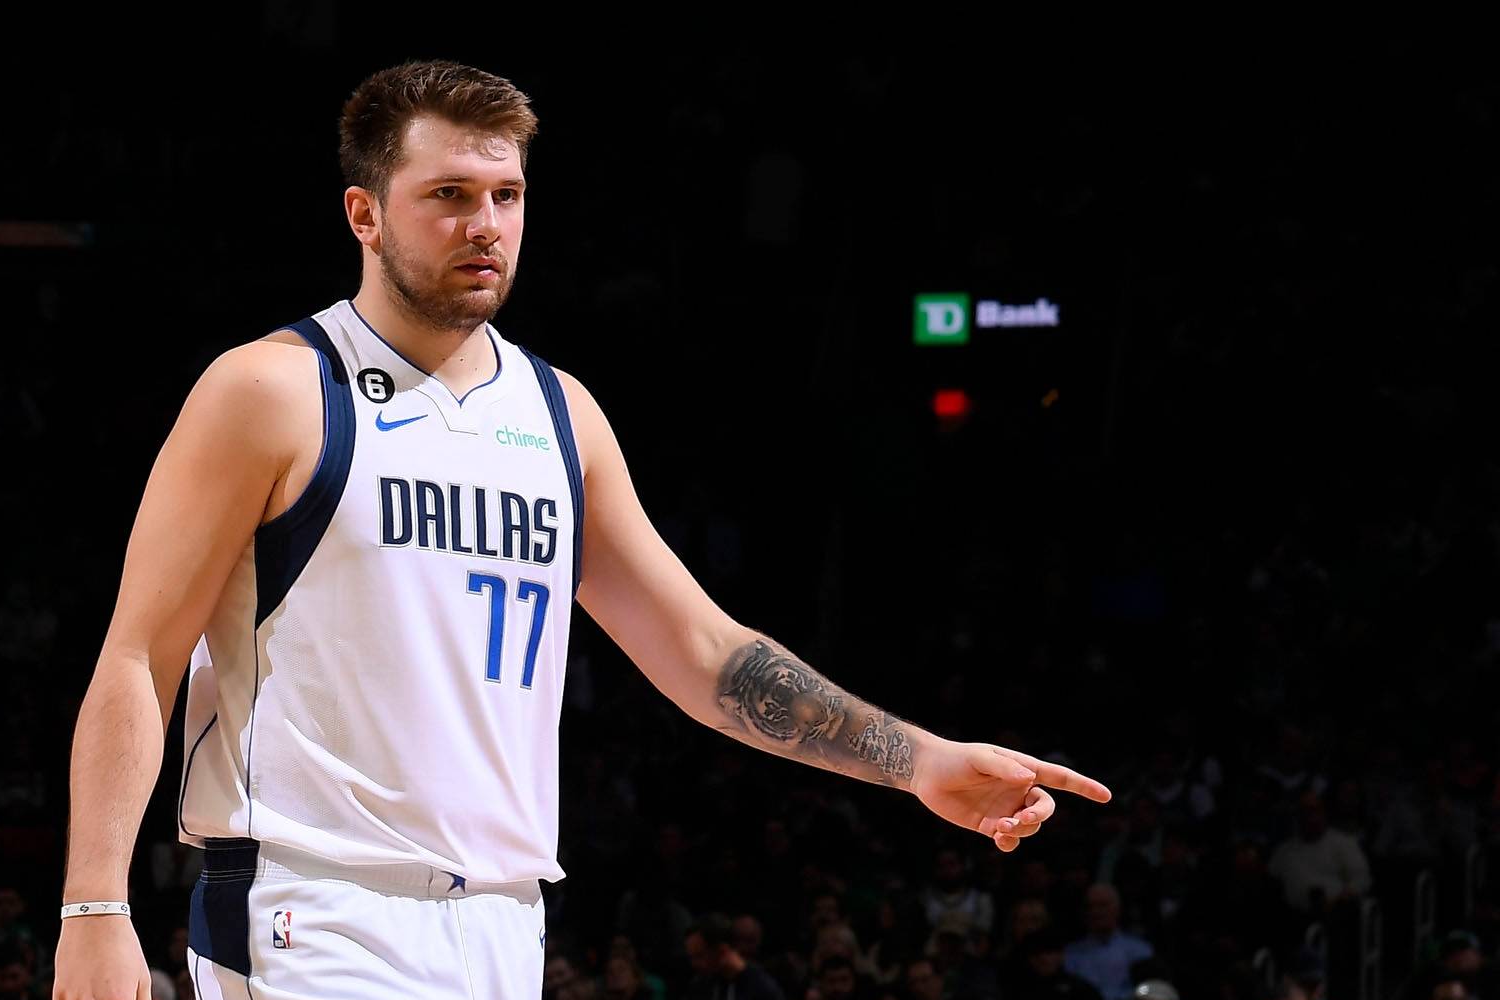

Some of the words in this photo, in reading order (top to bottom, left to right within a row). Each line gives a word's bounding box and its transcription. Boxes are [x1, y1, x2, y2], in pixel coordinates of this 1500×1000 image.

[919, 302, 965, 335] TD
[976, 298, 1058, 328] Bank
[364, 373, 386, 394] 6
[496, 426, 550, 450] chime
[377, 475, 559, 566] DALLAS
[466, 570, 551, 690] 77
